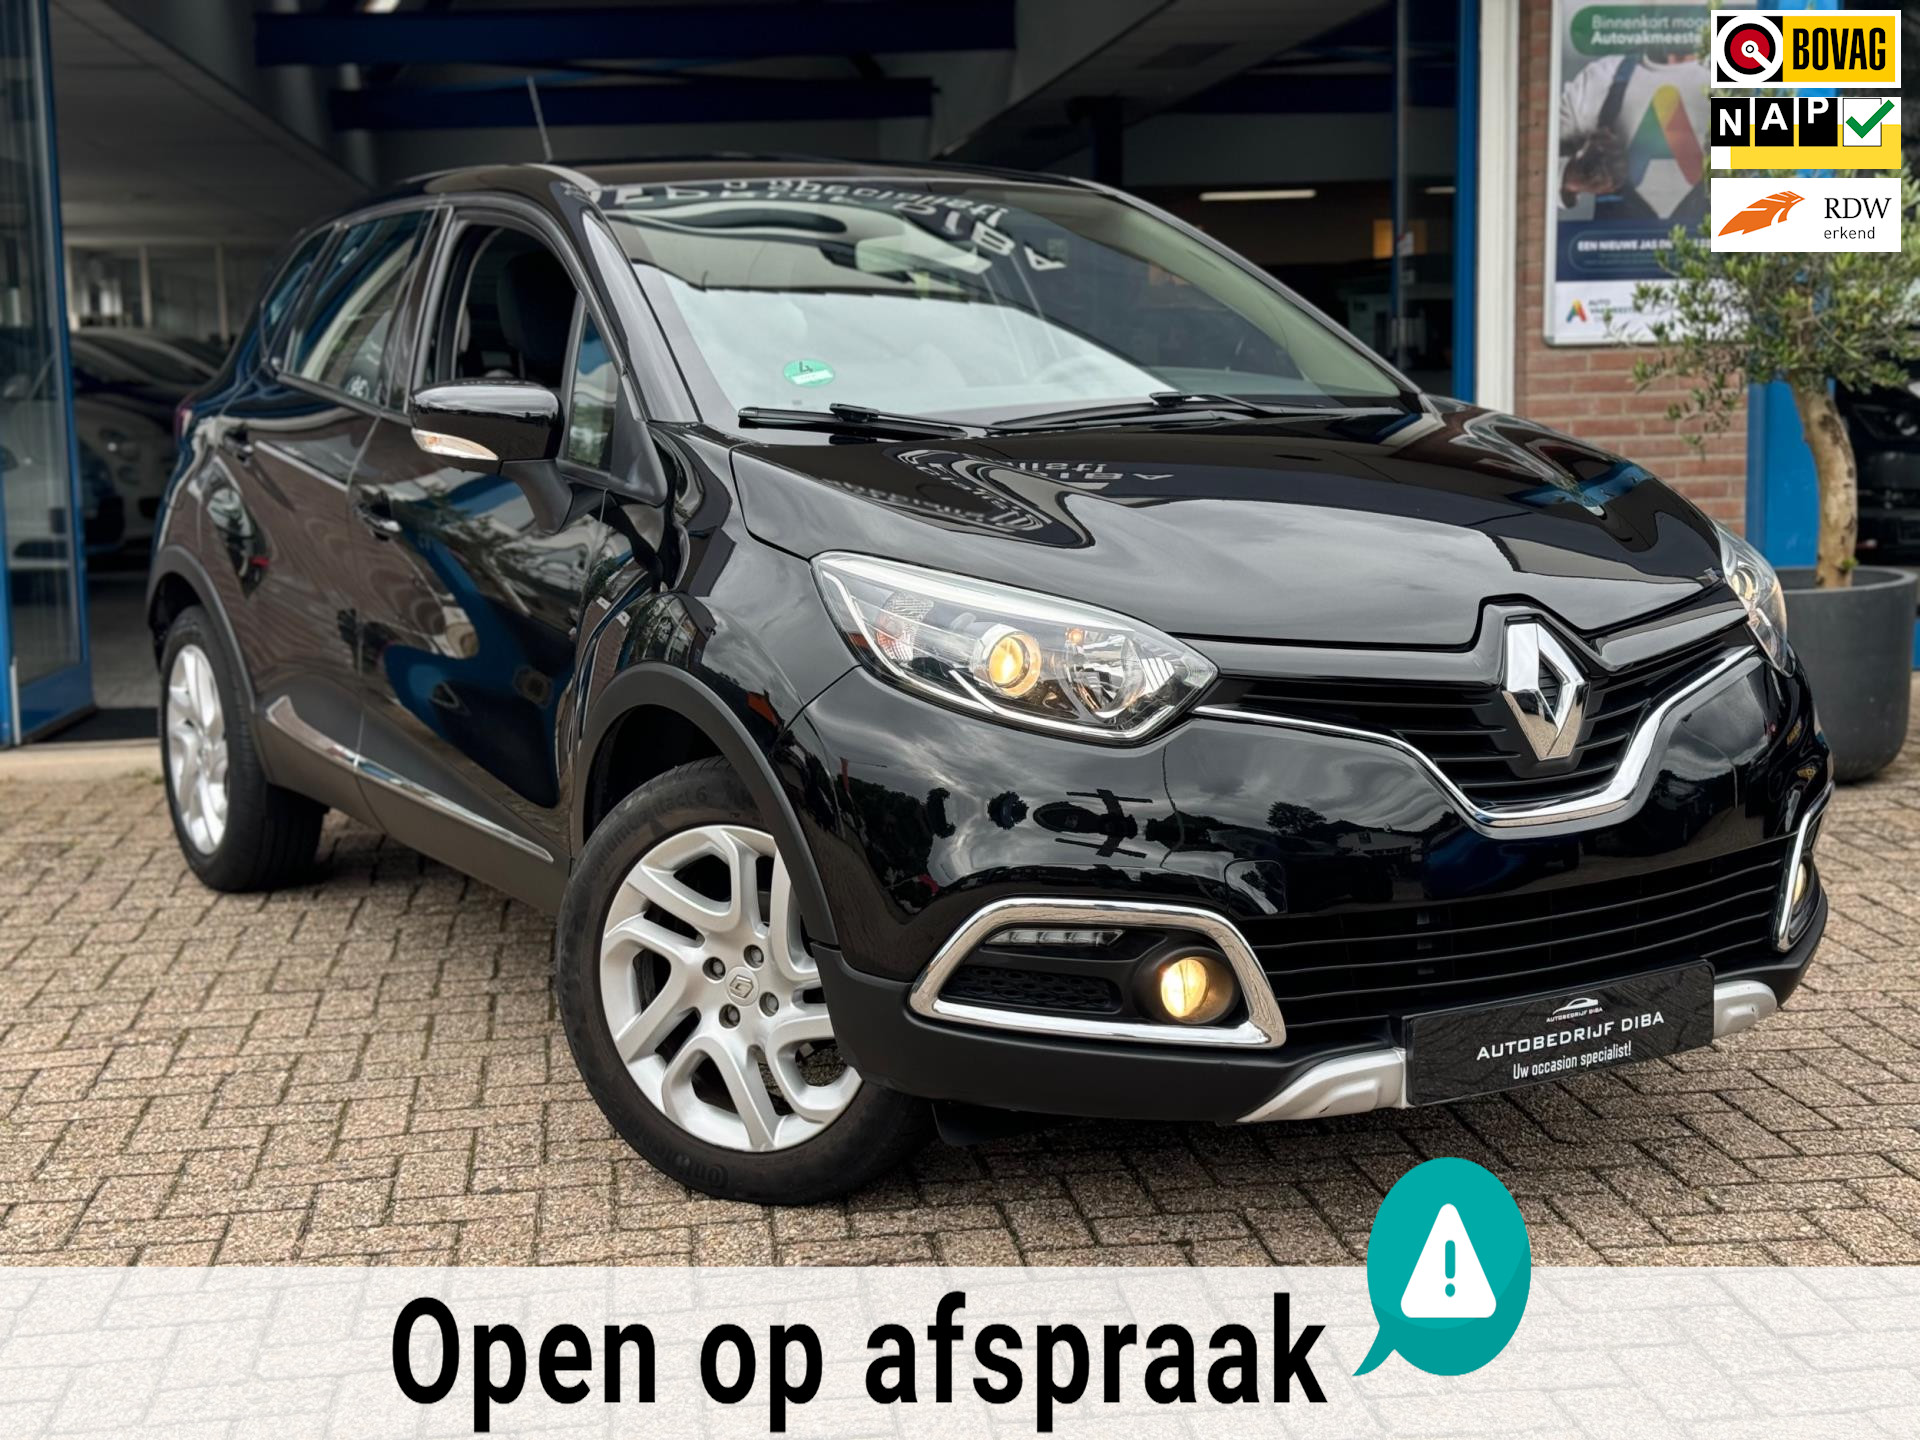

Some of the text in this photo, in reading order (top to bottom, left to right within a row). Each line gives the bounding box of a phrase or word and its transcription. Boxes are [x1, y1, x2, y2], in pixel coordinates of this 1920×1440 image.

[1592, 14, 1669, 30] Binnenkort
[1590, 29, 1703, 45] Autovakmeeste
[1475, 1010, 1666, 1062] AUTOBEDRIJF DIBA
[1512, 1039, 1632, 1081] Uw occasion specialist!
